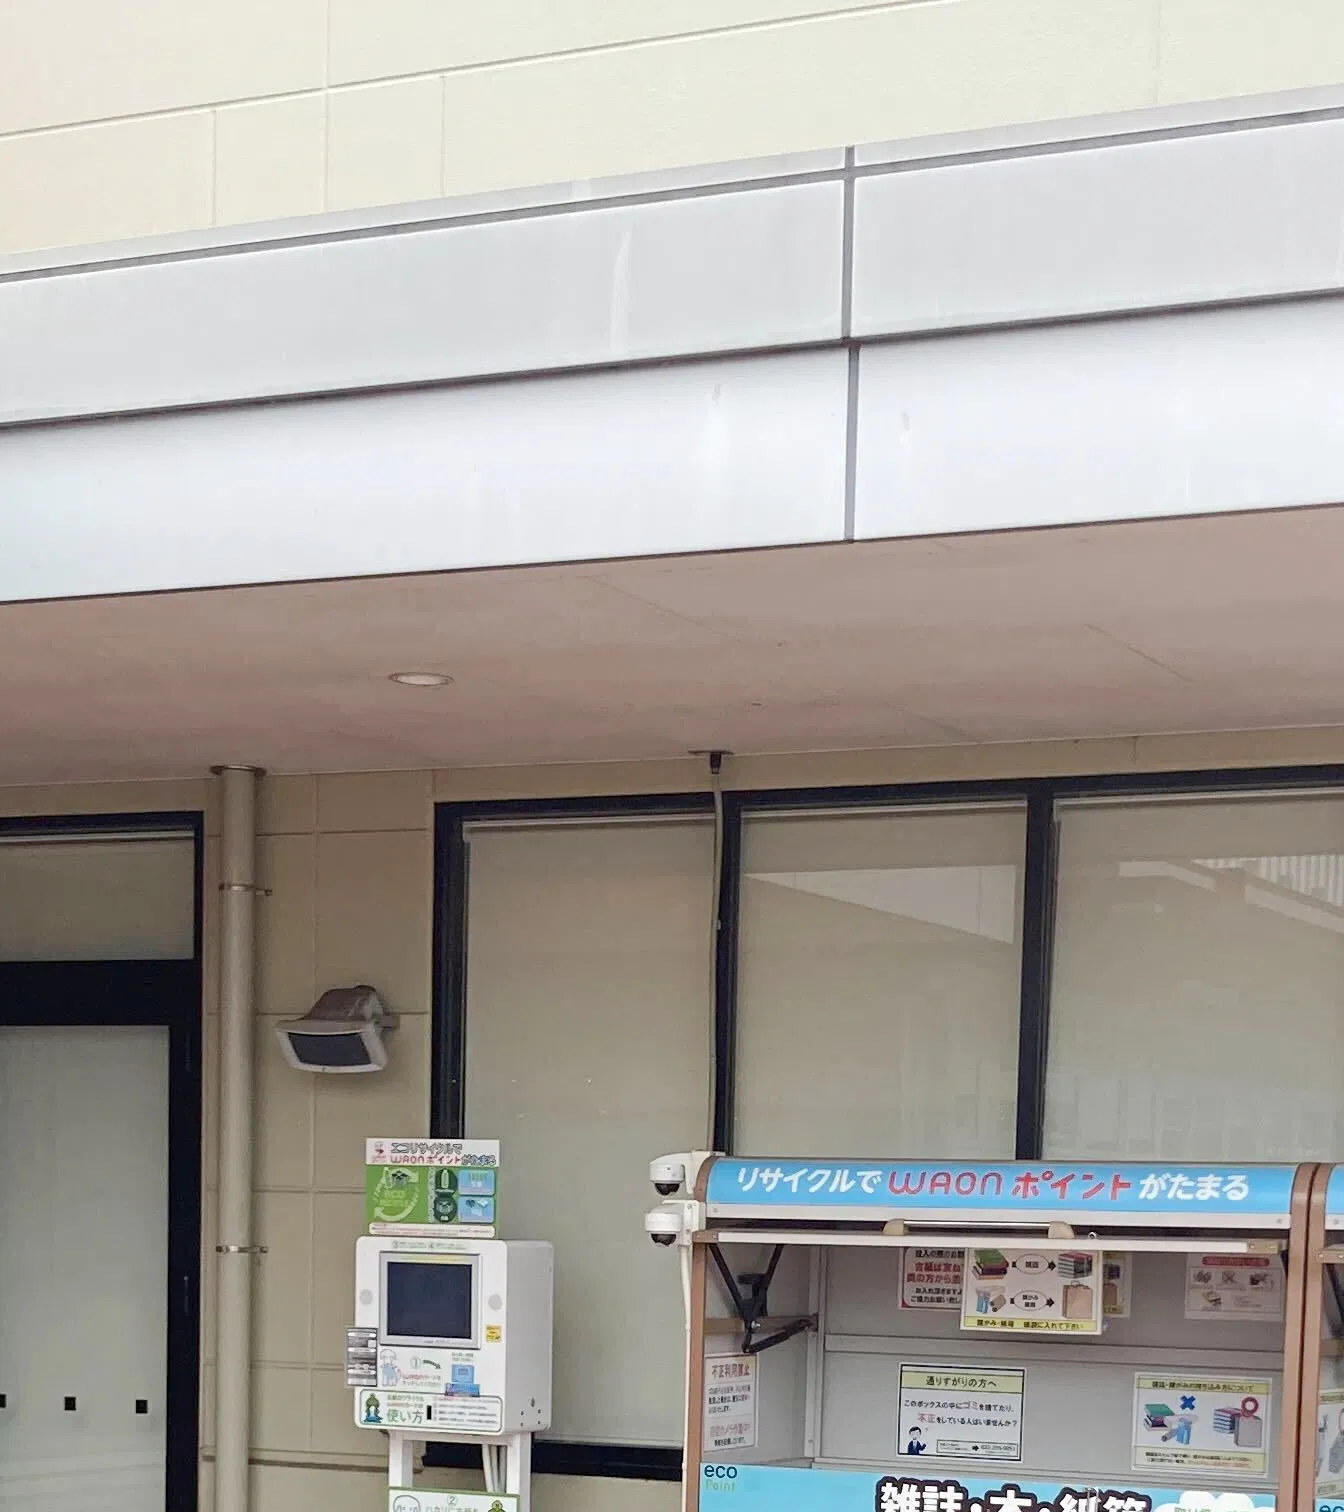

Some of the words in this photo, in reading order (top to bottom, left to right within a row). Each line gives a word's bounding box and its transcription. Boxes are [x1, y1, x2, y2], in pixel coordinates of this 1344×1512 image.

[737, 1167, 882, 1194] リサイクルで
[887, 1171, 1002, 1198] WAON
[1139, 1173, 1249, 1202] がたまる
[925, 1375, 998, 1389] 通りすがりの方へ
[386, 1408, 425, 1425] 使い方
[704, 1465, 737, 1479] eco
[705, 1480, 736, 1492] Point
